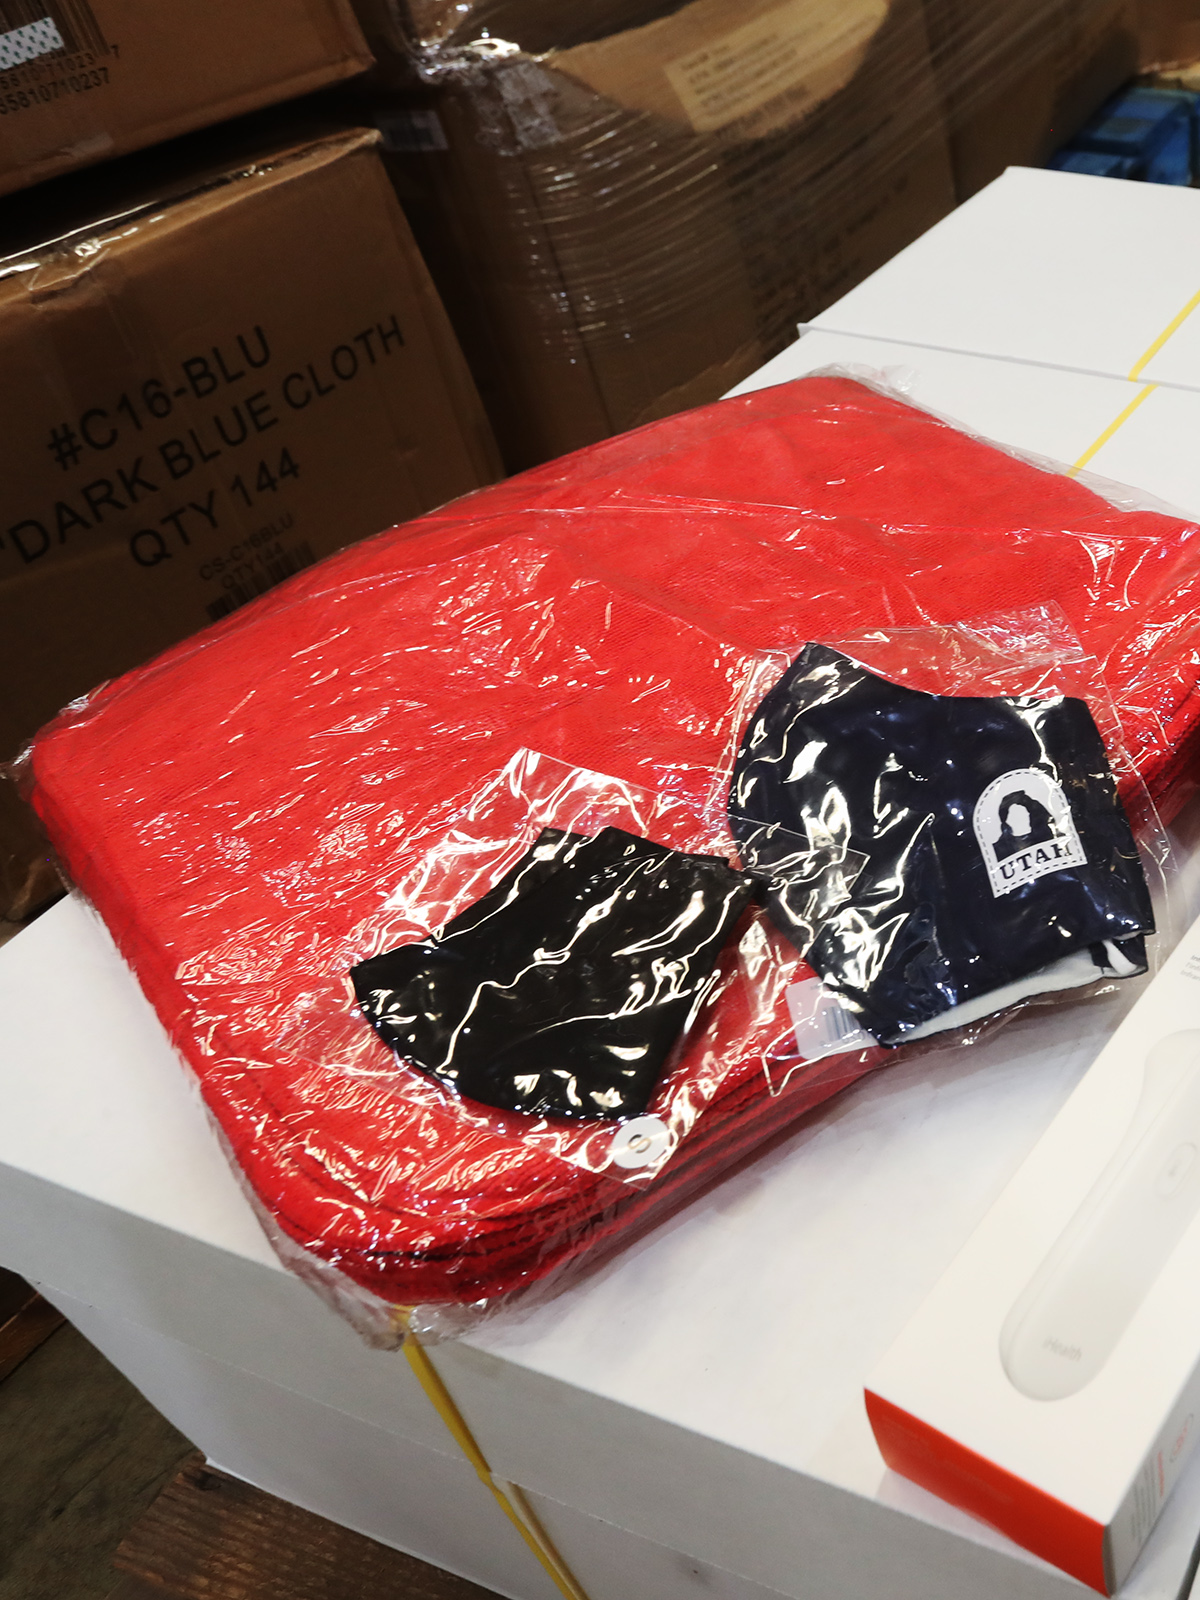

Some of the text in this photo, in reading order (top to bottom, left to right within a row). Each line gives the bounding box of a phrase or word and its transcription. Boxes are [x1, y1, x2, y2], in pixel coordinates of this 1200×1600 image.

[46, 325, 272, 471] #C16-BLU
[159, 391, 279, 479] BLUE
[281, 315, 405, 411] CLOTH
[129, 448, 300, 567] QTY 144
[999, 842, 1073, 880] UTAH
